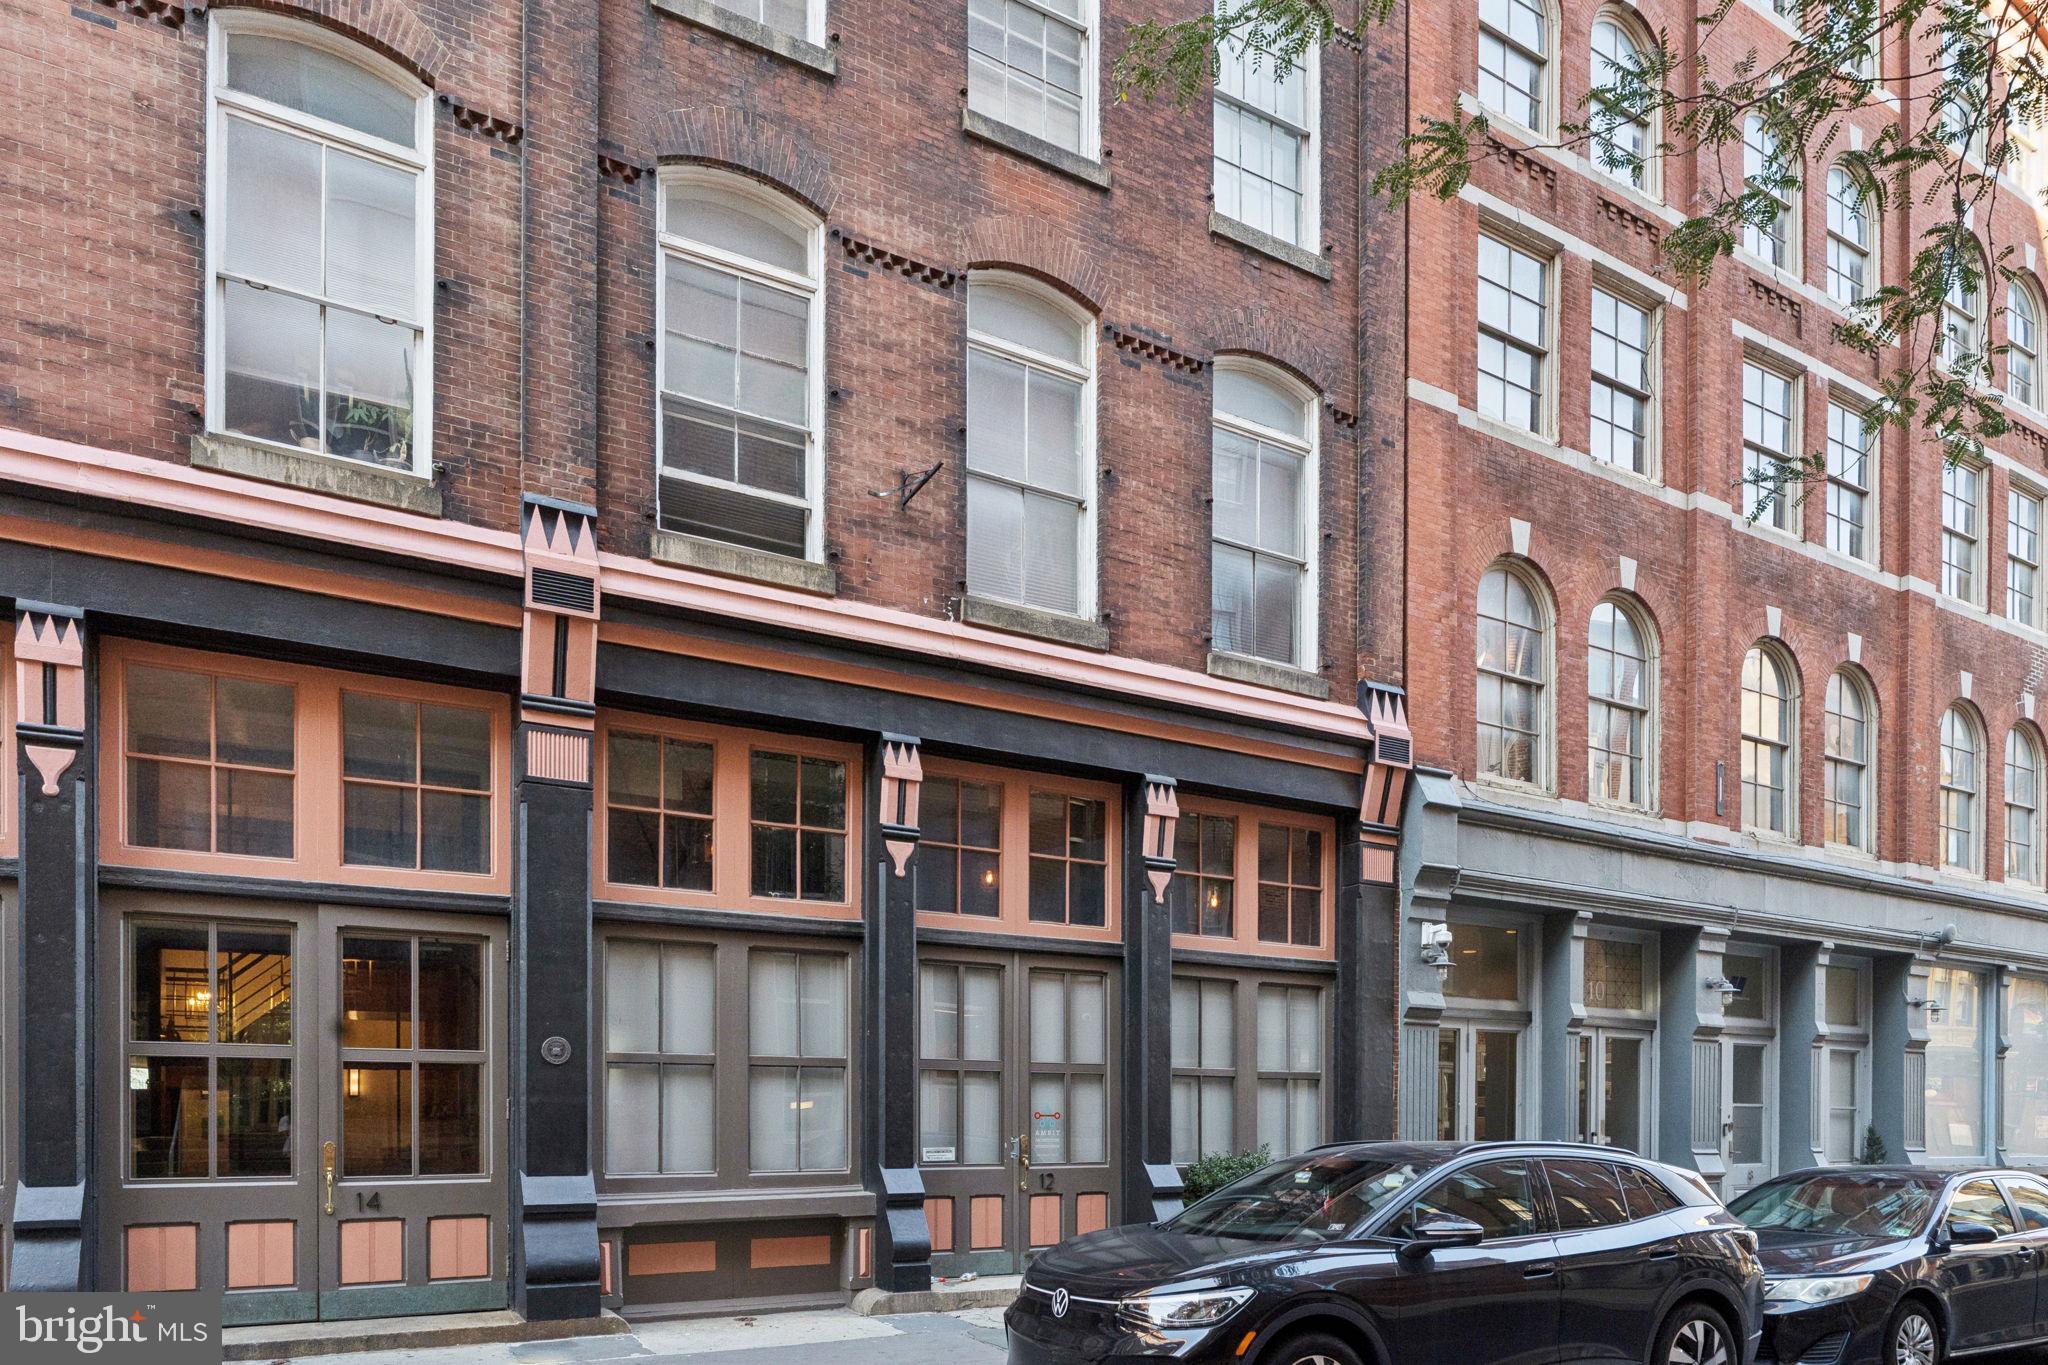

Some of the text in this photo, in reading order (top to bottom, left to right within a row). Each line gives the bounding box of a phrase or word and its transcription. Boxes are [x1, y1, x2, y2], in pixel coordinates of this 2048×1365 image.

[1587, 980, 1605, 1001] 10
[1040, 1173, 1054, 1190] 12
[356, 1191, 380, 1212] 14
